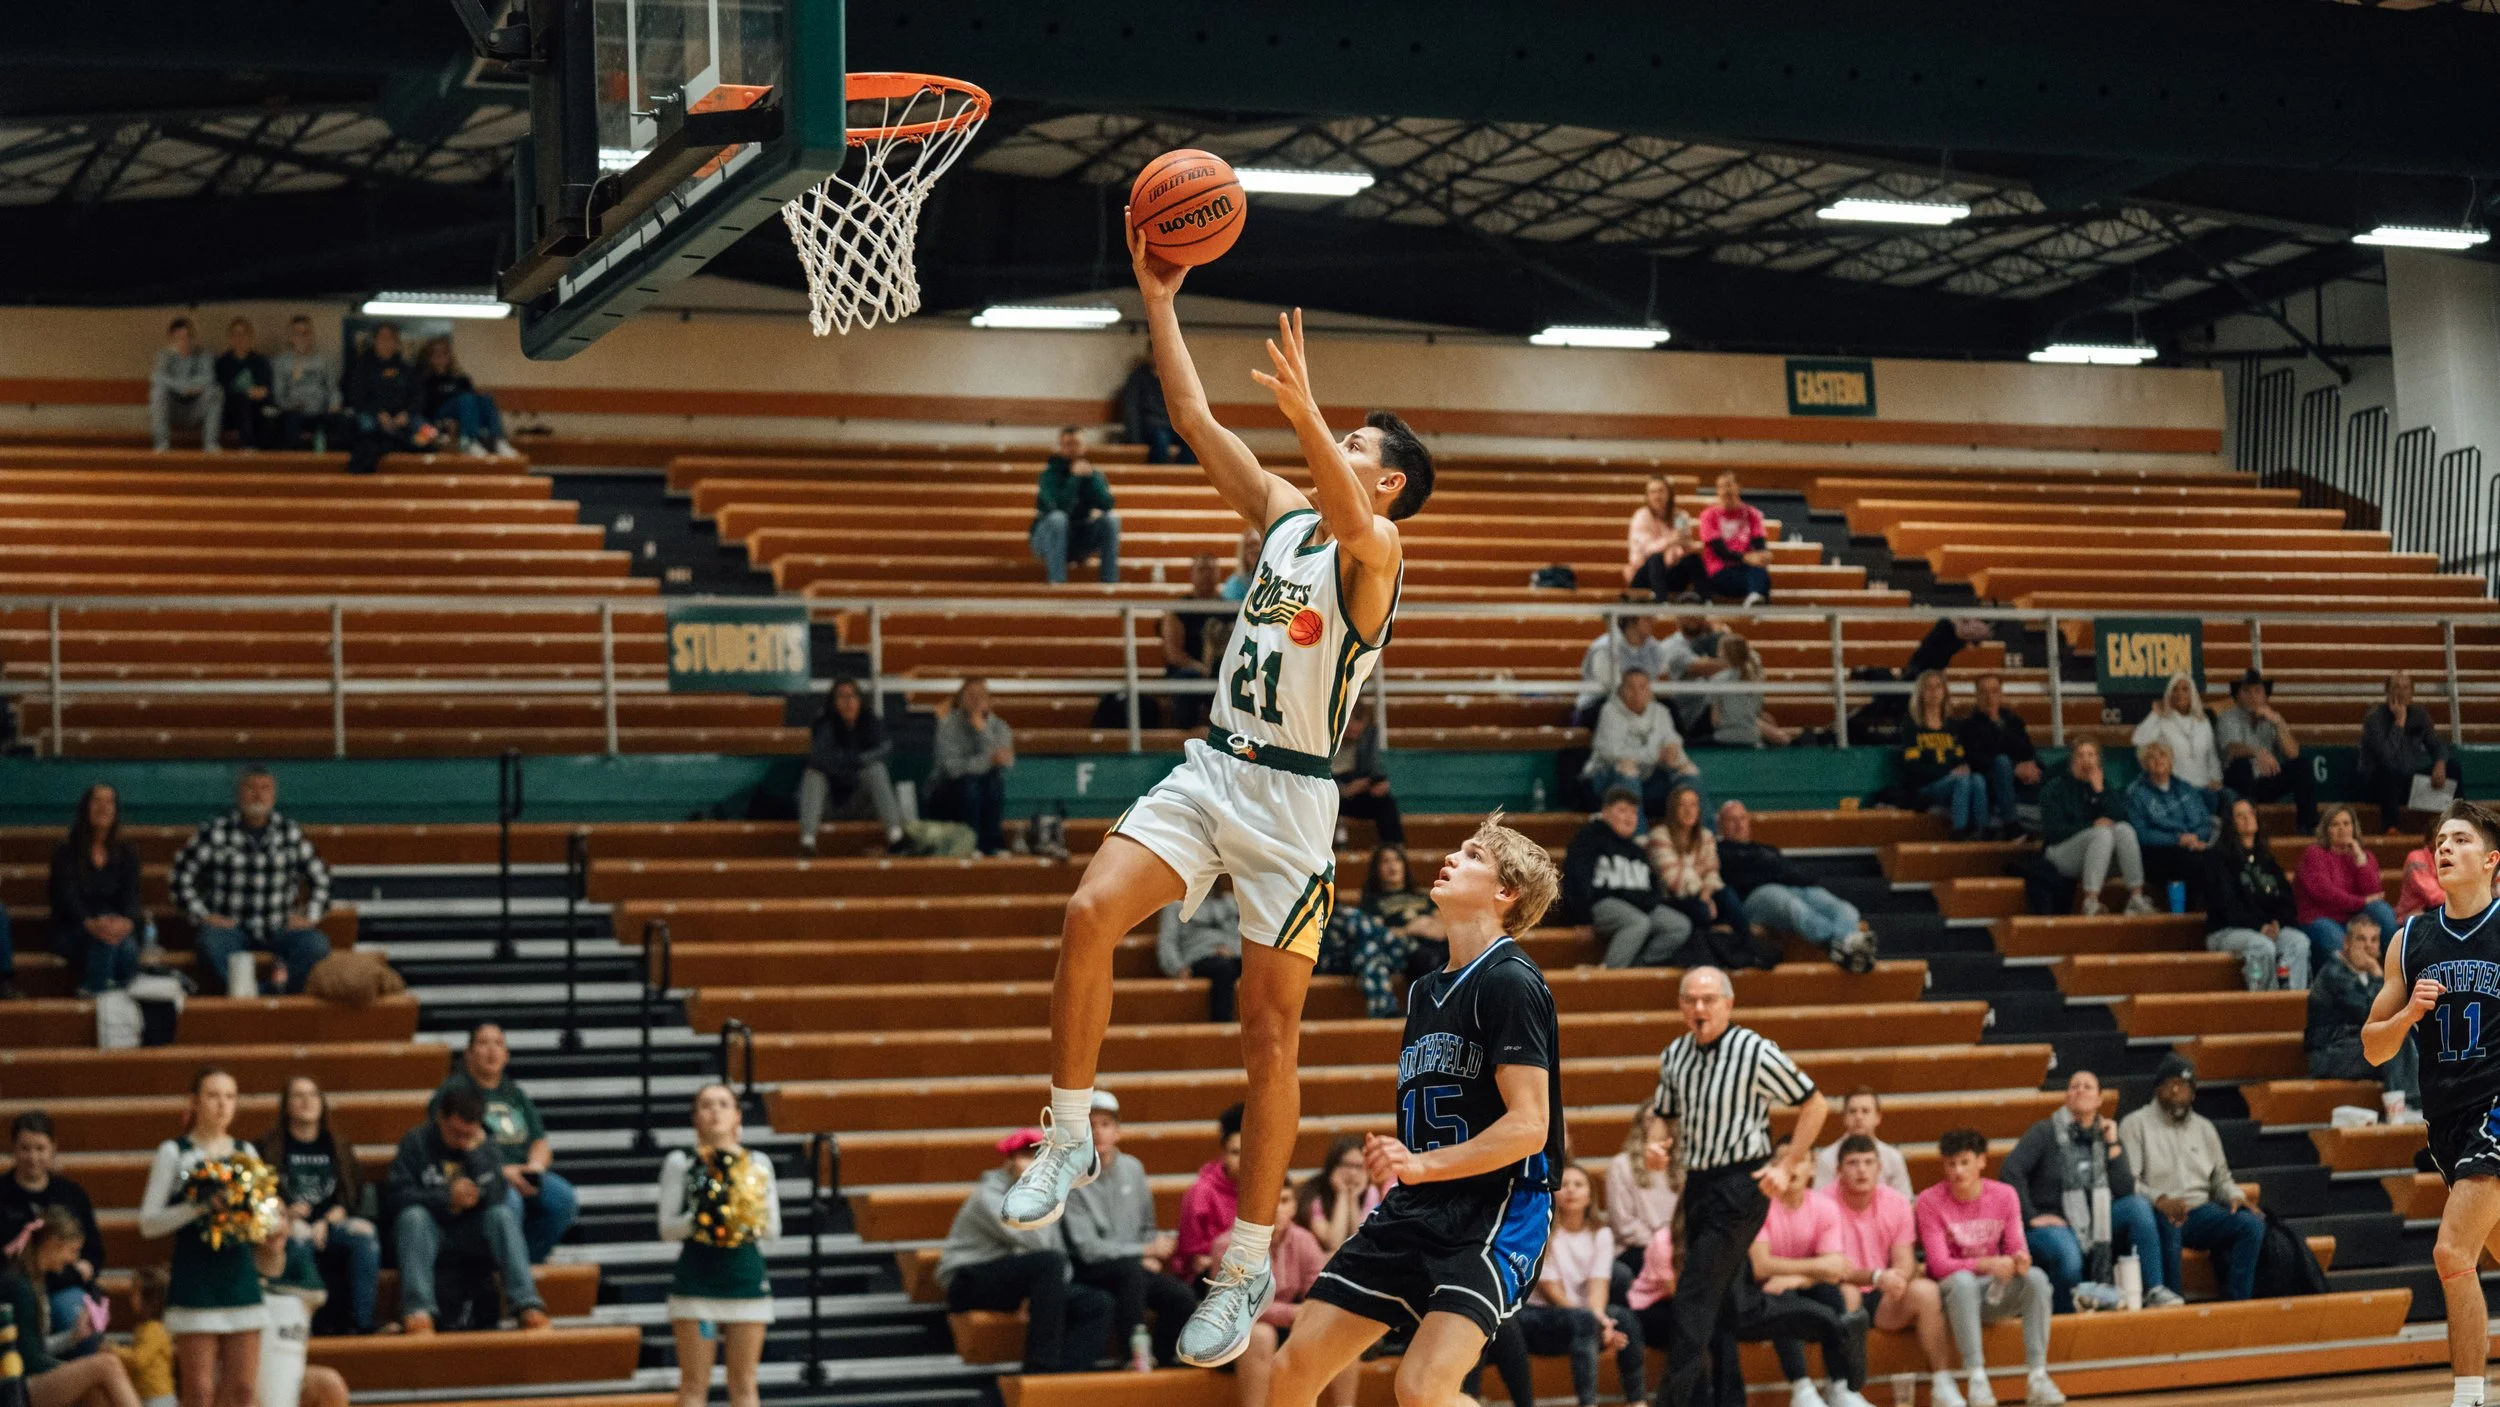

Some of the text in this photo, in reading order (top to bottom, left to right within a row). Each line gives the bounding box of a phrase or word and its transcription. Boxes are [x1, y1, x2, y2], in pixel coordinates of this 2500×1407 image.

[1149, 167, 1216, 203] EVOLUTION
[1157, 194, 1234, 235] Wilson
[1795, 370, 1866, 405] EASTERN
[672, 623, 804, 673] STUDENTS
[2106, 633, 2192, 678] EASTERN
[1231, 636, 1283, 726] 21
[1077, 762, 1096, 795] F
[2313, 755, 2328, 782] G
[2415, 960, 2500, 999] RTHFIEL
[2435, 1002, 2486, 1062] 11
[1402, 1084, 1469, 1152] 15
